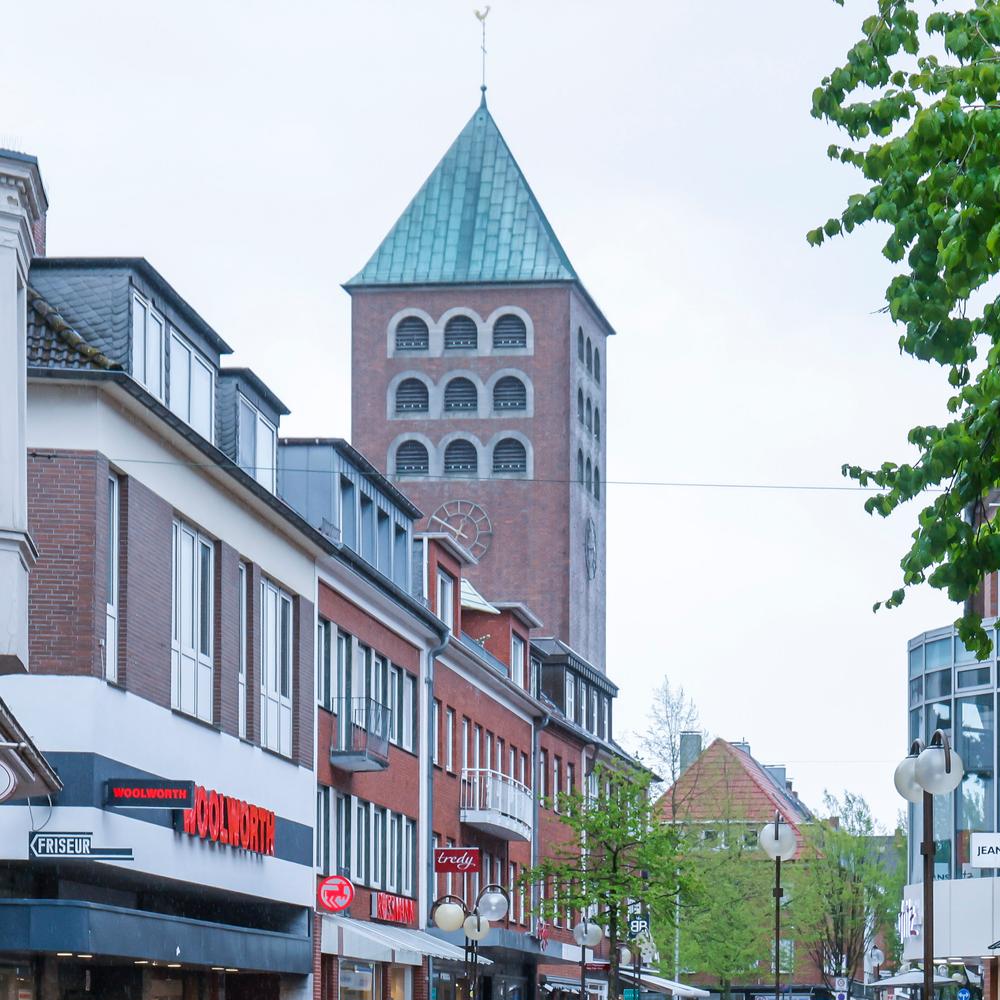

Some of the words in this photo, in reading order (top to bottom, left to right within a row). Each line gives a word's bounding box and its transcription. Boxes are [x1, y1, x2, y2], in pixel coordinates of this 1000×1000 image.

[112, 787, 188, 799] WOOLWORTH
[183, 784, 275, 857] WOOLWORTH
[37, 838, 91, 854] FRISEUR
[437, 851, 476, 870] tredy
